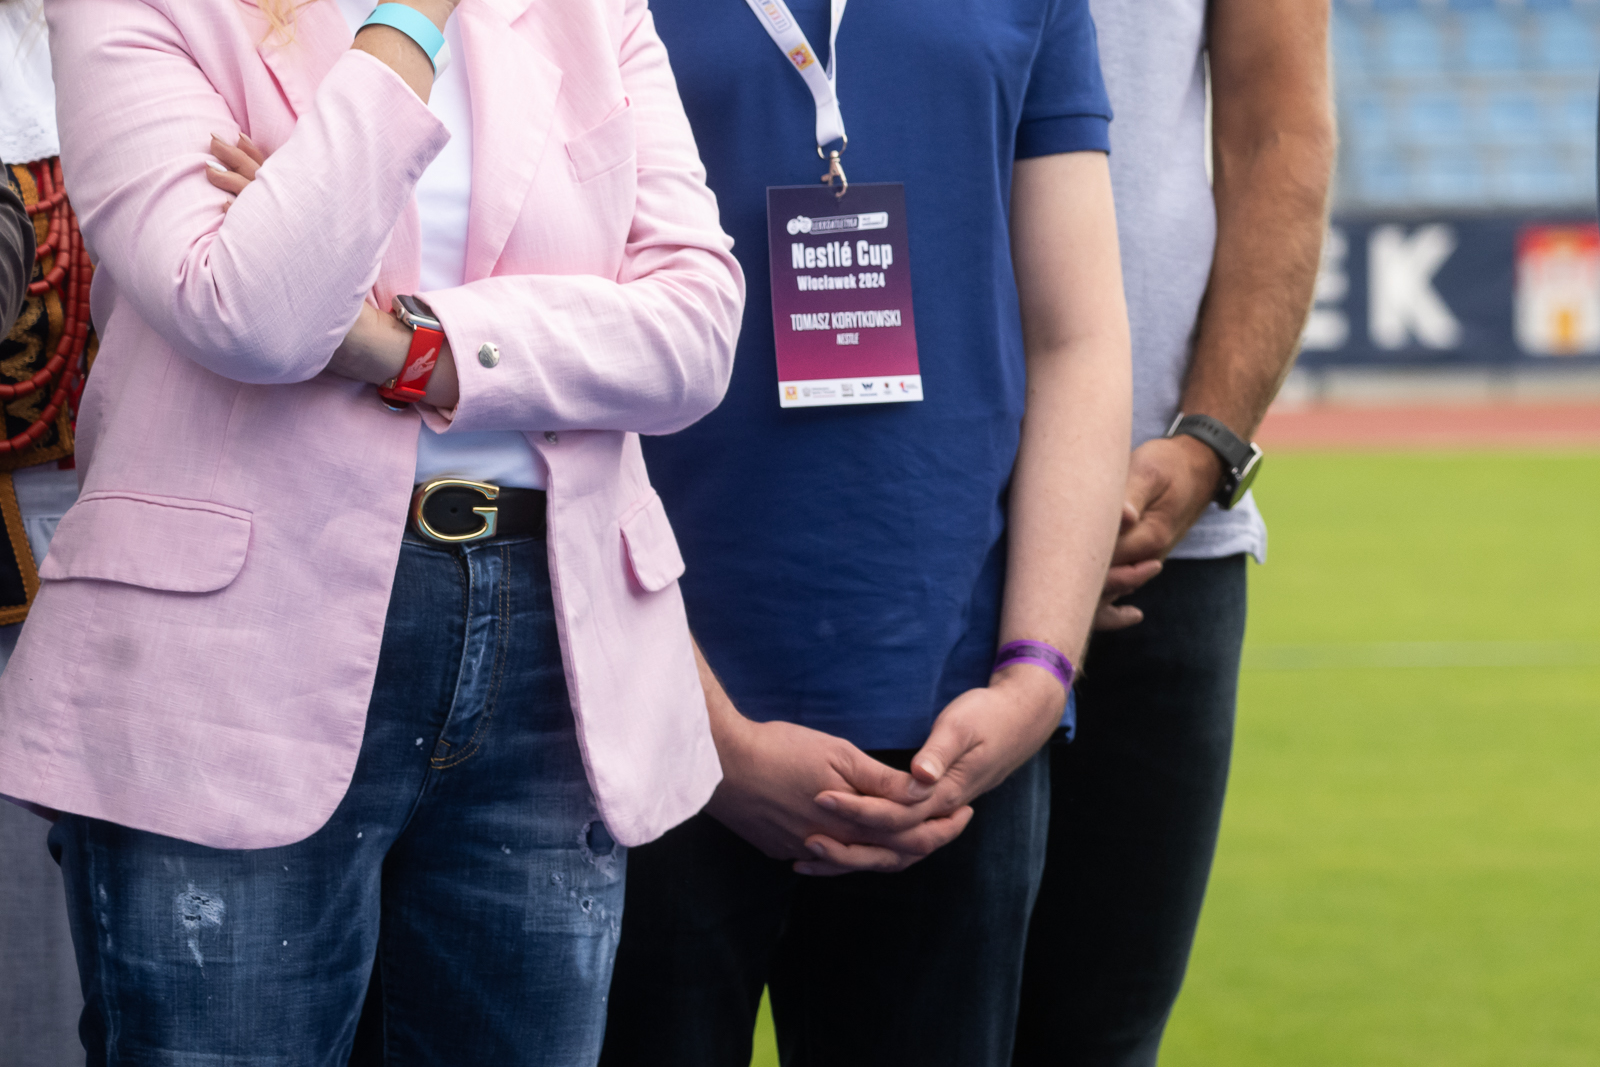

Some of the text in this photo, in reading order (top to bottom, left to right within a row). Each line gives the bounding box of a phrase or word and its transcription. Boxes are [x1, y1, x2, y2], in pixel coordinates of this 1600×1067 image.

[791, 240, 893, 269] Nestlé Cup
[858, 272, 886, 289] 2024
[790, 310, 902, 331] TOMASZ KORYTKOWSKI
